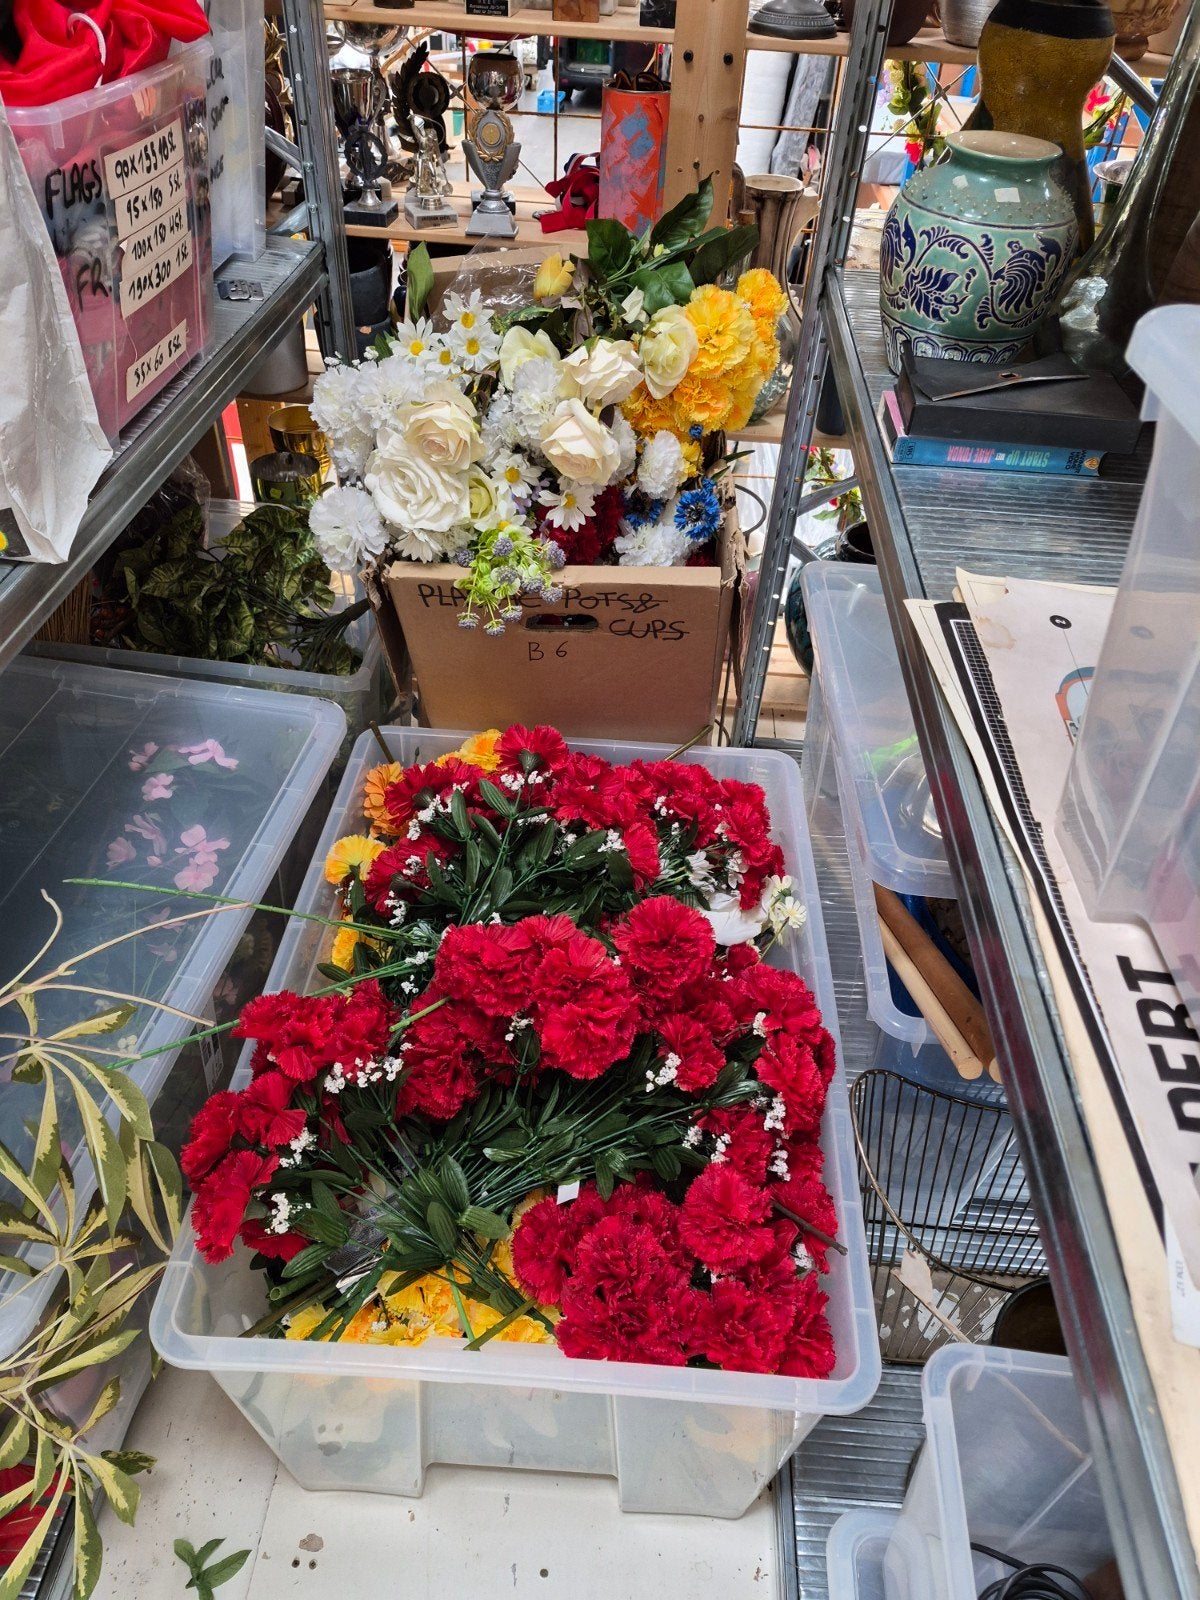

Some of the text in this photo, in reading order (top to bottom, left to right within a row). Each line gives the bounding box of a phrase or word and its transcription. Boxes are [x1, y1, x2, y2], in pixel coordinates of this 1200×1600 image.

[45, 159, 102, 220] FLAGS
[946, 445, 973, 462] FONDA
[973, 448, 996, 464] JANE
[1005, 449, 1020, 466] UP
[1020, 450, 1050, 467] START
[608, 618, 687, 640] CUPS
[527, 640, 568, 661] B 6
